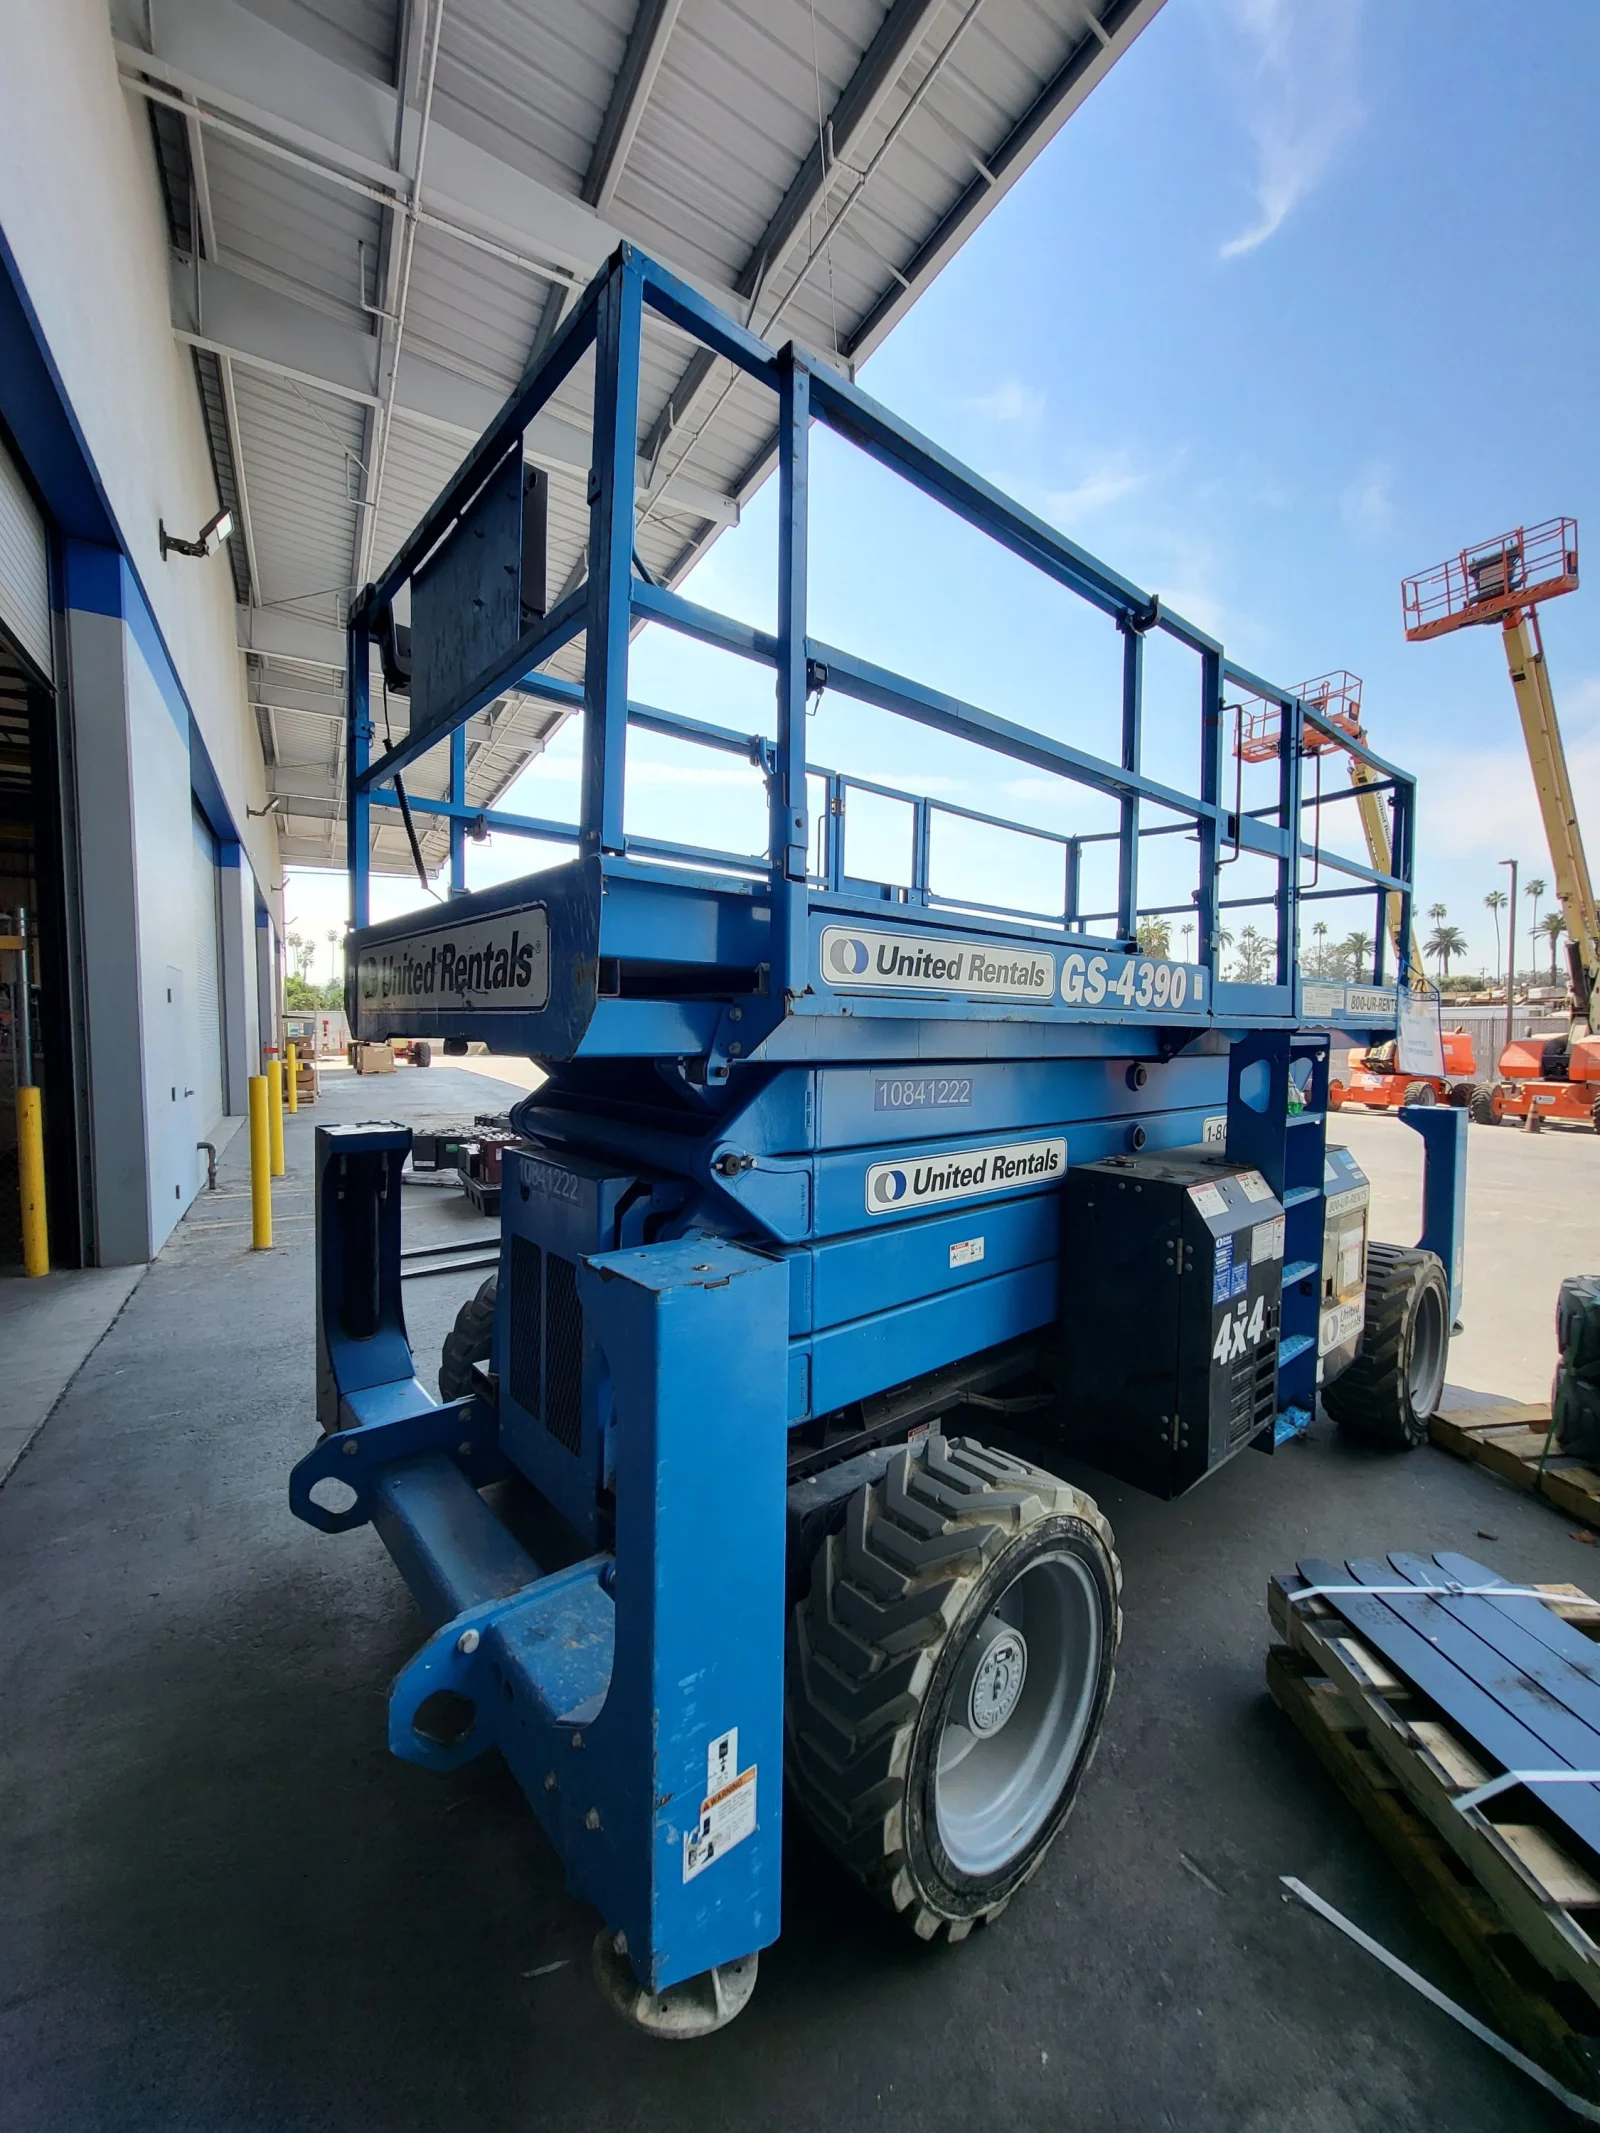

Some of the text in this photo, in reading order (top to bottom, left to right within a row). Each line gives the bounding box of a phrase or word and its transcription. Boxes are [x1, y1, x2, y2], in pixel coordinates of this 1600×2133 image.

[382, 931, 534, 998] United Rentals
[876, 944, 1045, 988] United Rentals
[1060, 953, 1186, 1008] GS-4390
[879, 1080, 971, 1107] 10841222
[518, 1157, 579, 1200] 10841222
[913, 1148, 1058, 1194] United Rentals
[1212, 1294, 1265, 1366] 4x4
